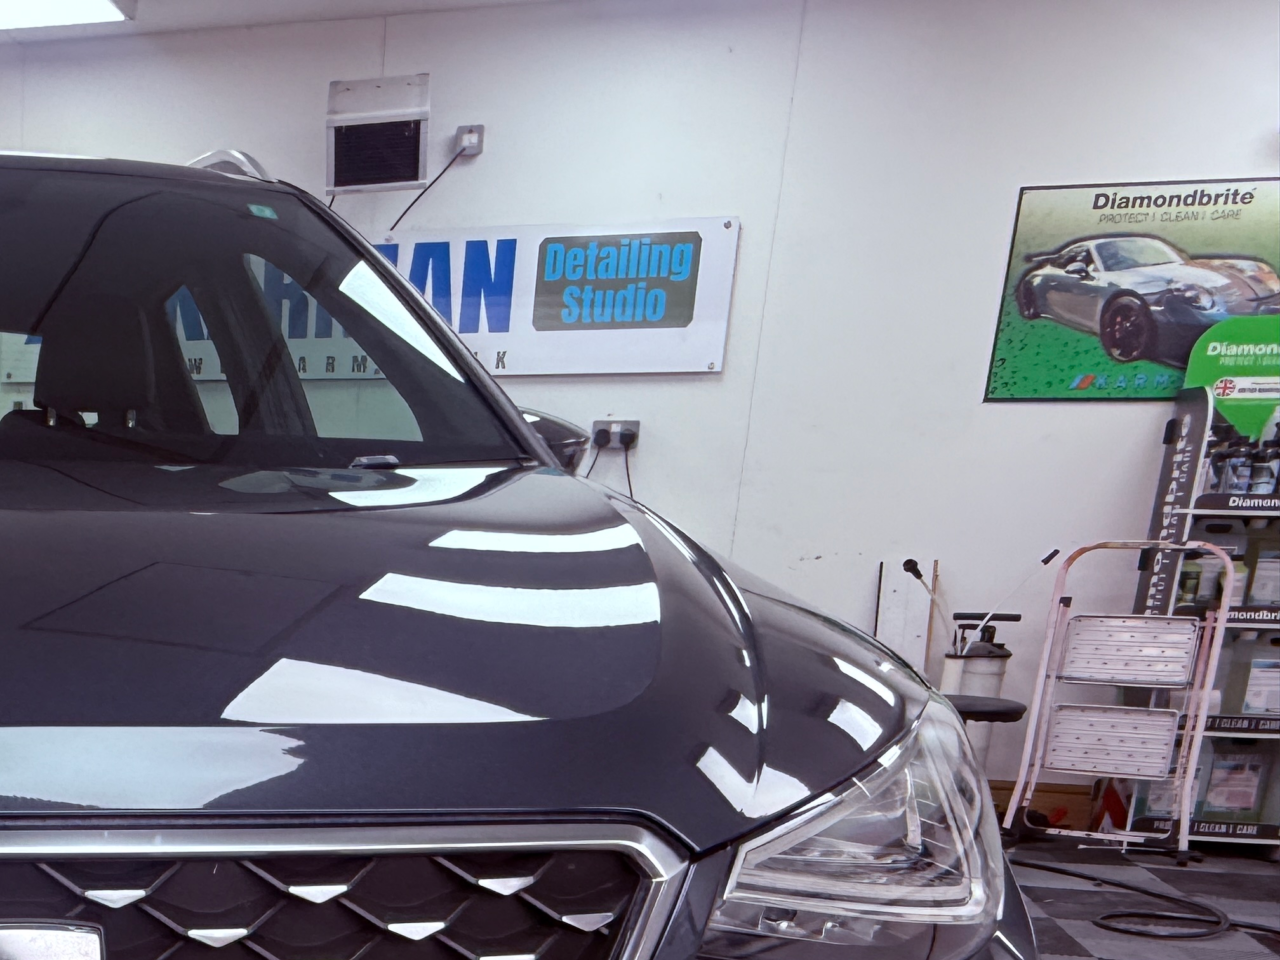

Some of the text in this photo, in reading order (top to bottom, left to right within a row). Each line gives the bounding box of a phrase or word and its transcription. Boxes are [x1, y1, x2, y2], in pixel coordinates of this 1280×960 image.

[1092, 189, 1255, 210] Diamondbrite
[1098, 209, 1242, 224] PROTECT CLEAN CARE
[544, 238, 693, 281] Detailing
[561, 282, 666, 324] Studio
[1207, 342, 1280, 355] Diamon
[1095, 374, 1170, 390] KARM
[1228, 496, 1280, 507] Diamon
